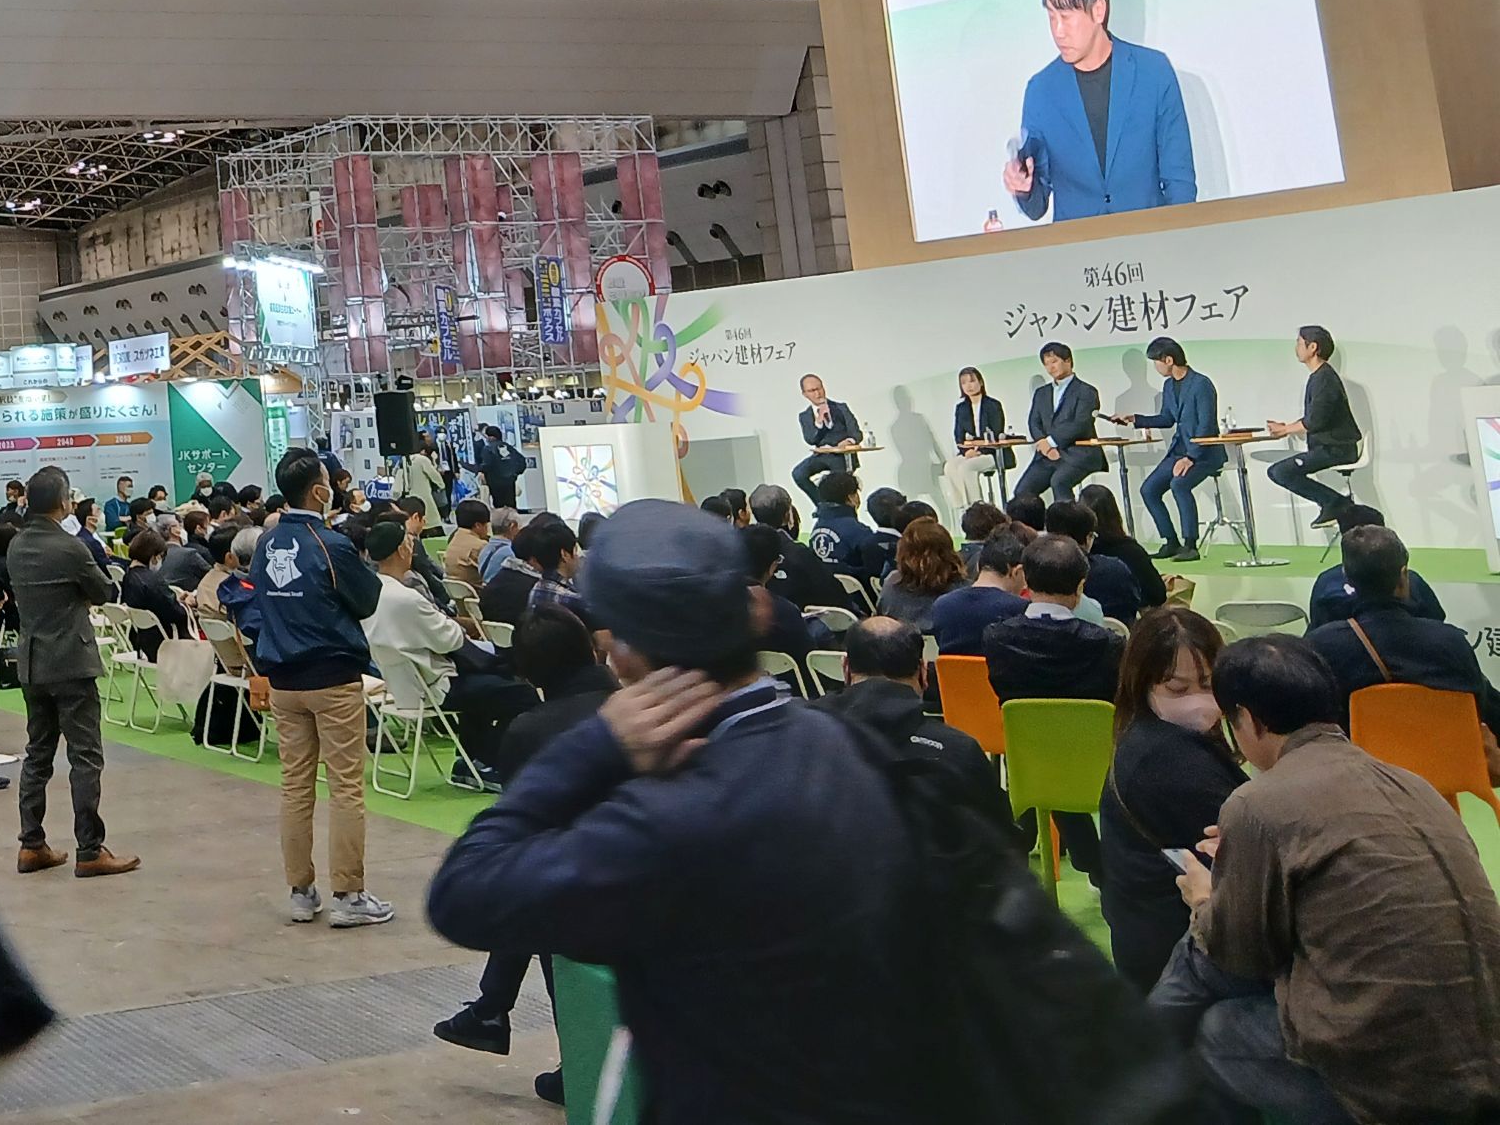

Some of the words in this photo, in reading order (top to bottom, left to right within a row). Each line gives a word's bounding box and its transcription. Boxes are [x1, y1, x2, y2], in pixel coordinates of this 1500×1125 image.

[1084, 261, 1145, 288] 第46回
[1004, 284, 1249, 339] ジャパン建材フェア
[689, 342, 796, 367] ジャパン建材フェア
[178, 448, 230, 461] JKサポート
[187, 462, 226, 473] センター
